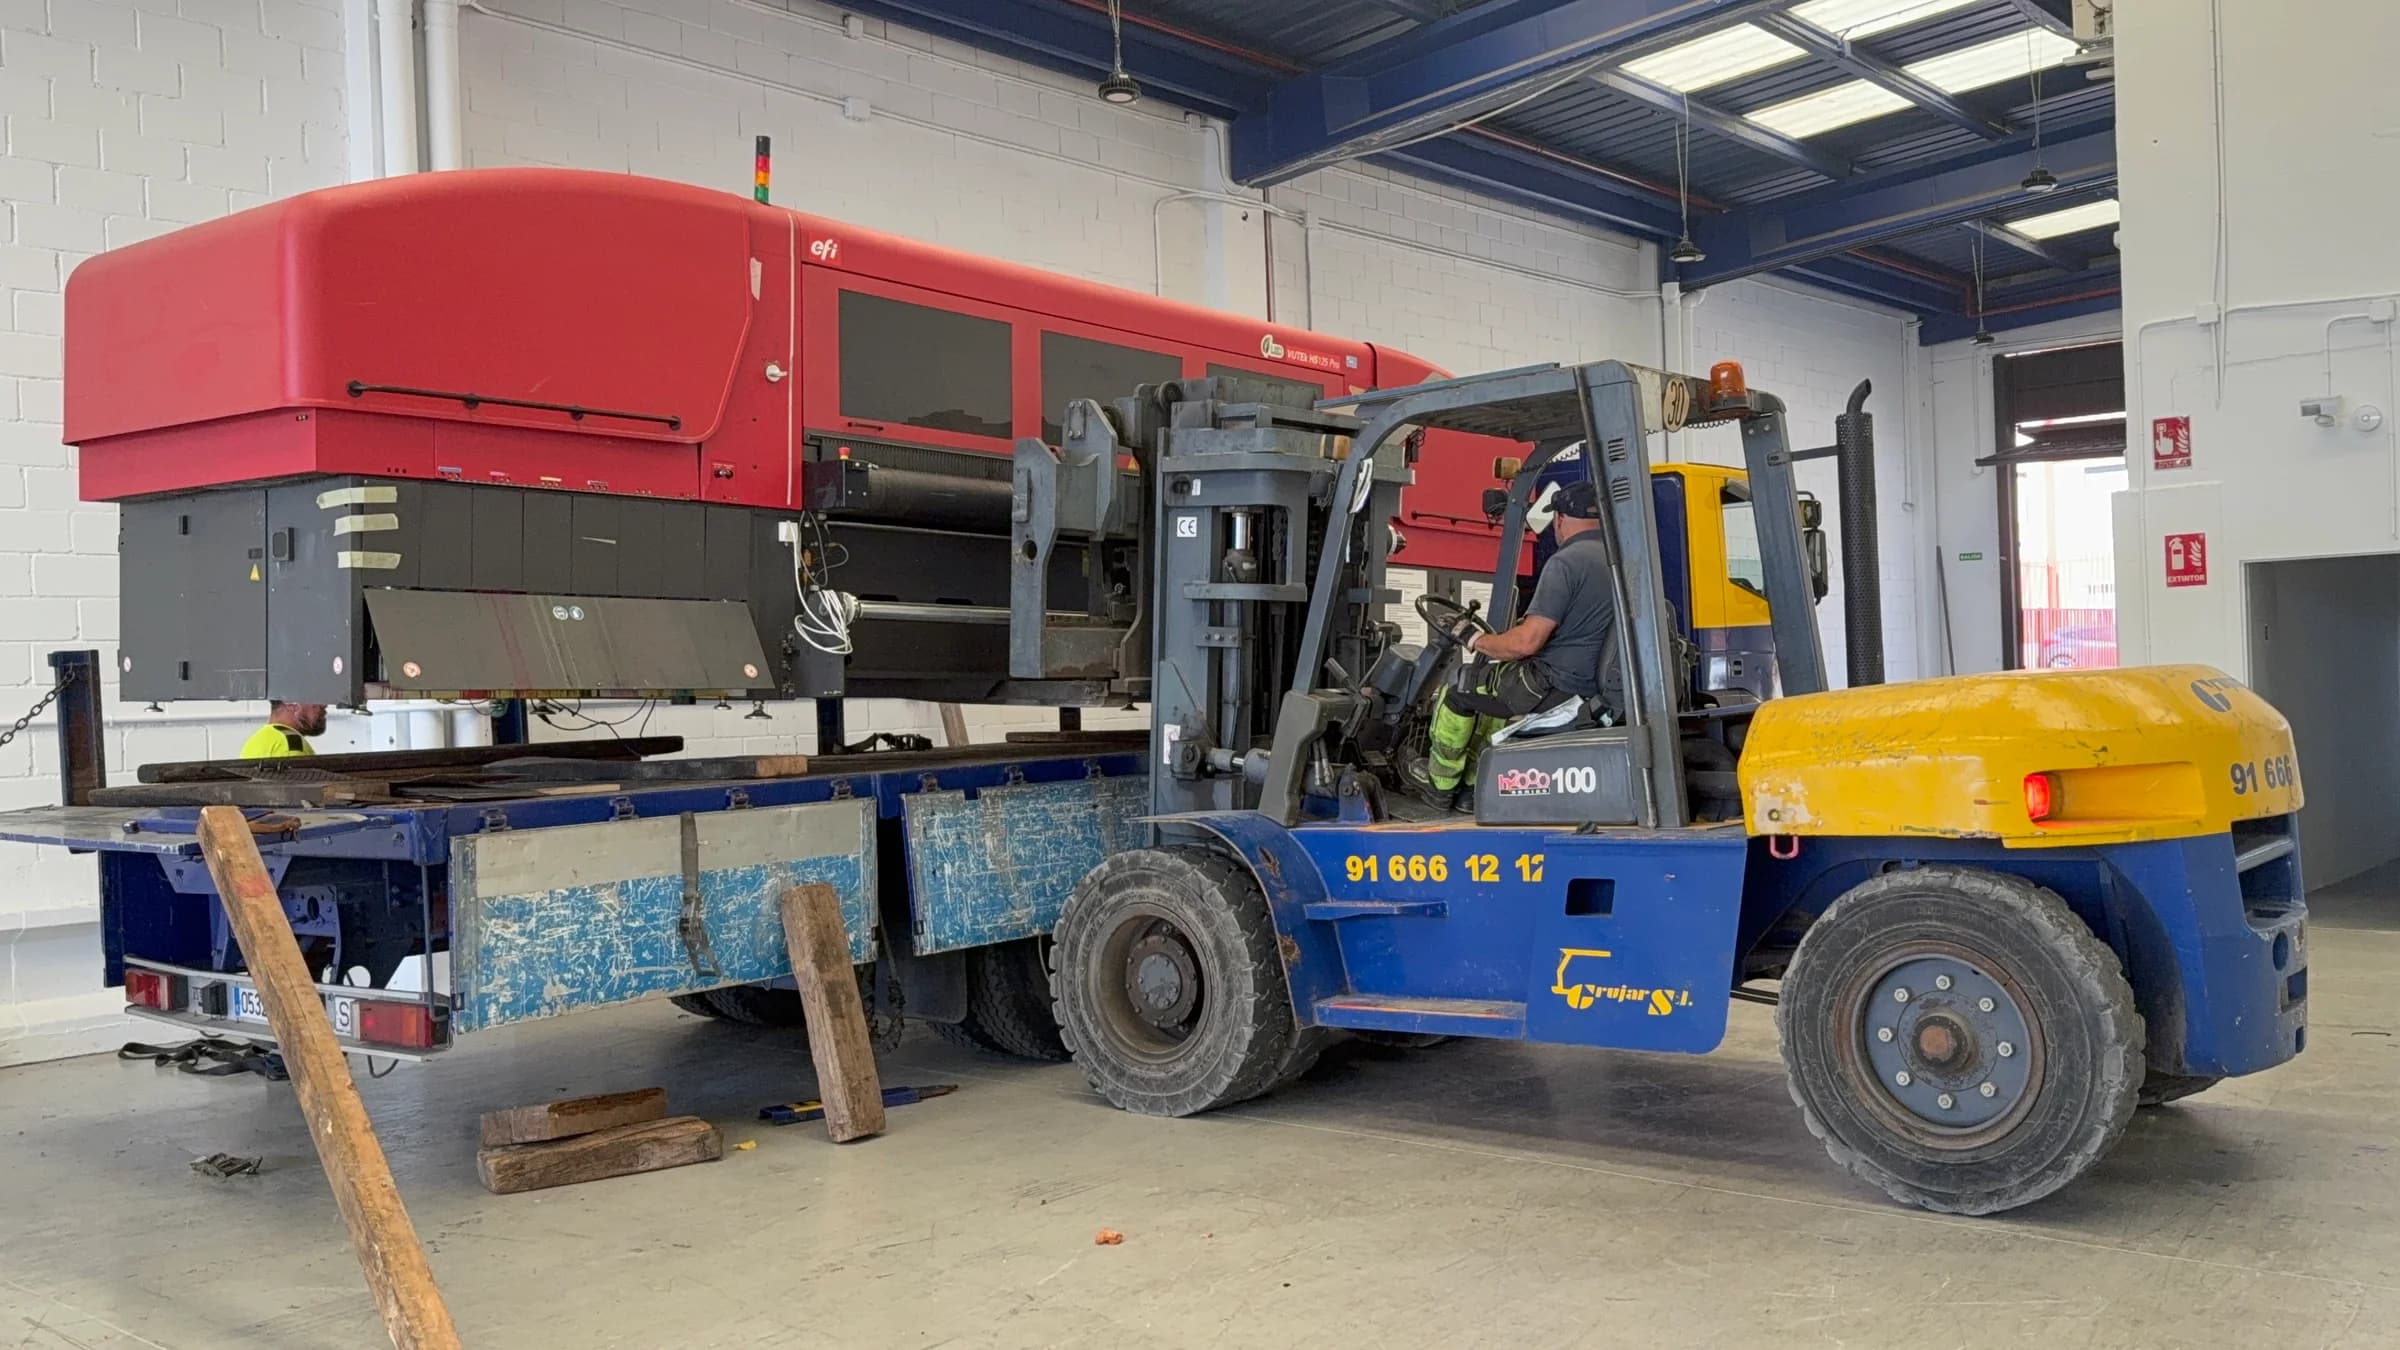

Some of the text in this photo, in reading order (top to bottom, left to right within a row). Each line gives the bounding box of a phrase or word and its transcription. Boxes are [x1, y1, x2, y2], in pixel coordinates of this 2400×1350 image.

[811, 239, 838, 261] efi
[1329, 358, 1340, 369] Pro
[1668, 381, 1684, 426] 30
[1179, 519, 1195, 535] CE
[2167, 574, 2205, 583] EXTINTOR
[1552, 766, 1596, 793] 100
[2230, 754, 2293, 795] 91 666
[1345, 855, 1378, 882] 91
[1388, 855, 1448, 882] 666
[1465, 854, 1500, 882] 12
[339, 1001, 350, 1027] S
